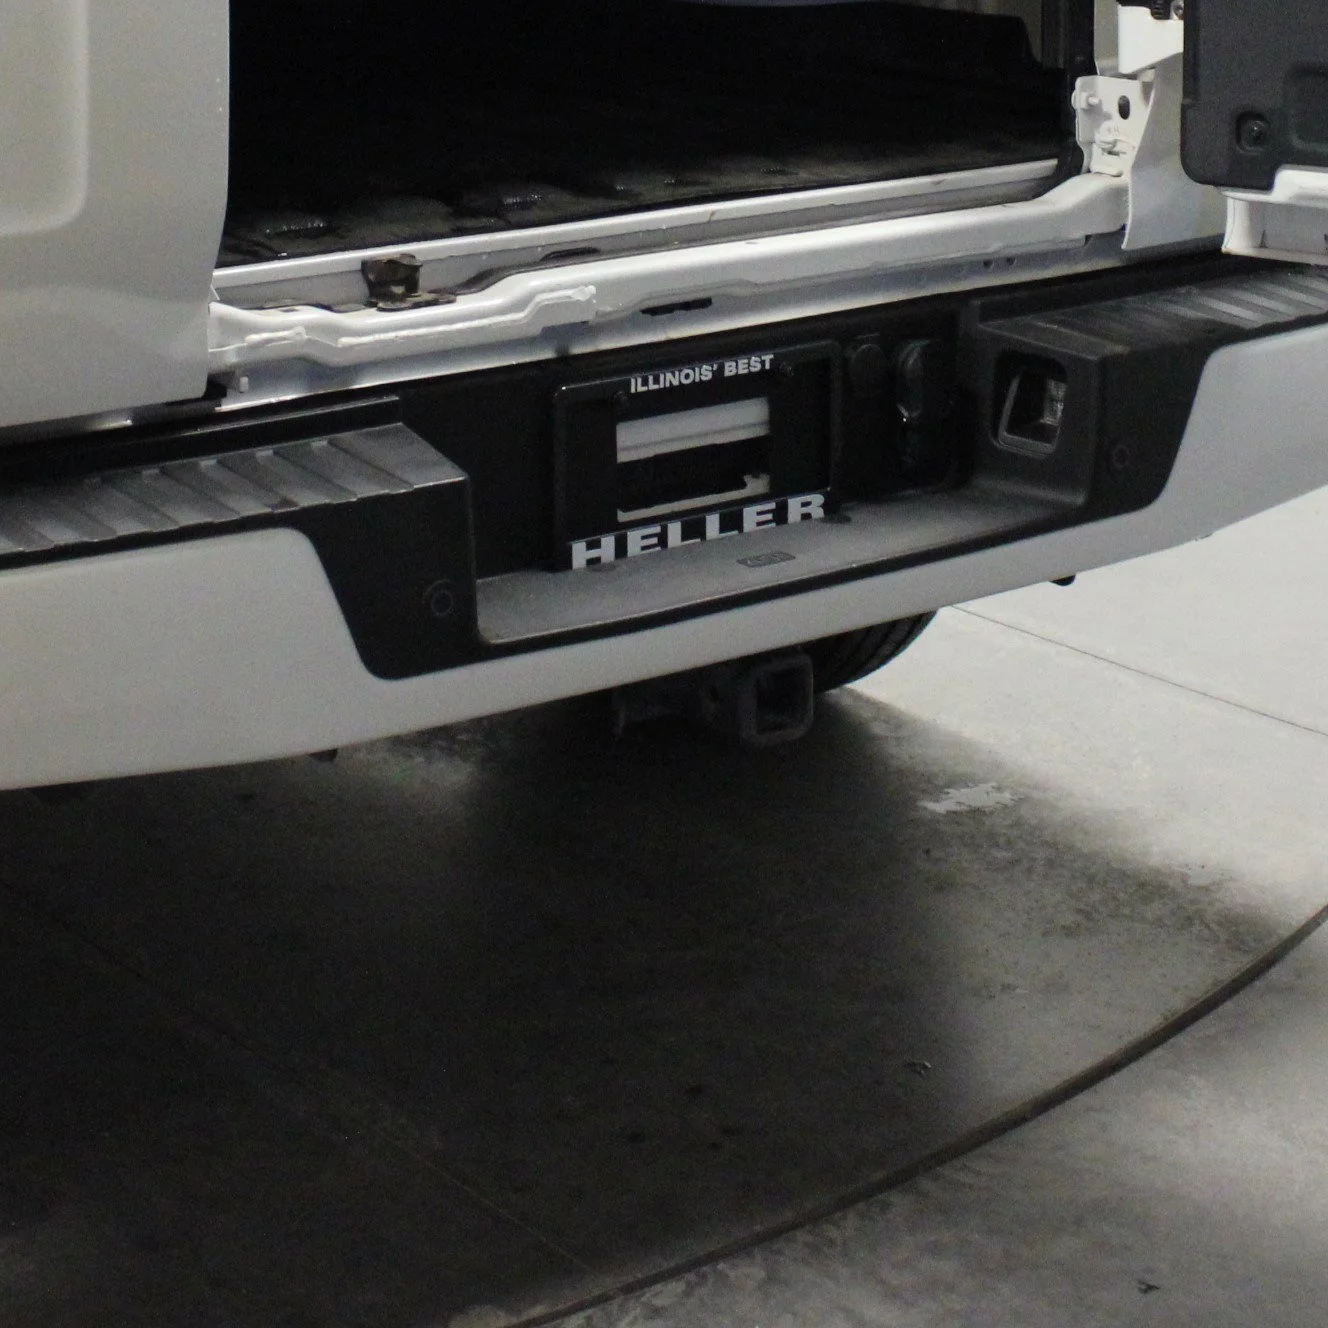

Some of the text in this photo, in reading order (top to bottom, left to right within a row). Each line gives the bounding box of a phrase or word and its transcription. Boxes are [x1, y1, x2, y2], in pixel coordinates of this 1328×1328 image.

[629, 354, 774, 393] ILLINOIS' BEST
[571, 493, 826, 570] HELLER
